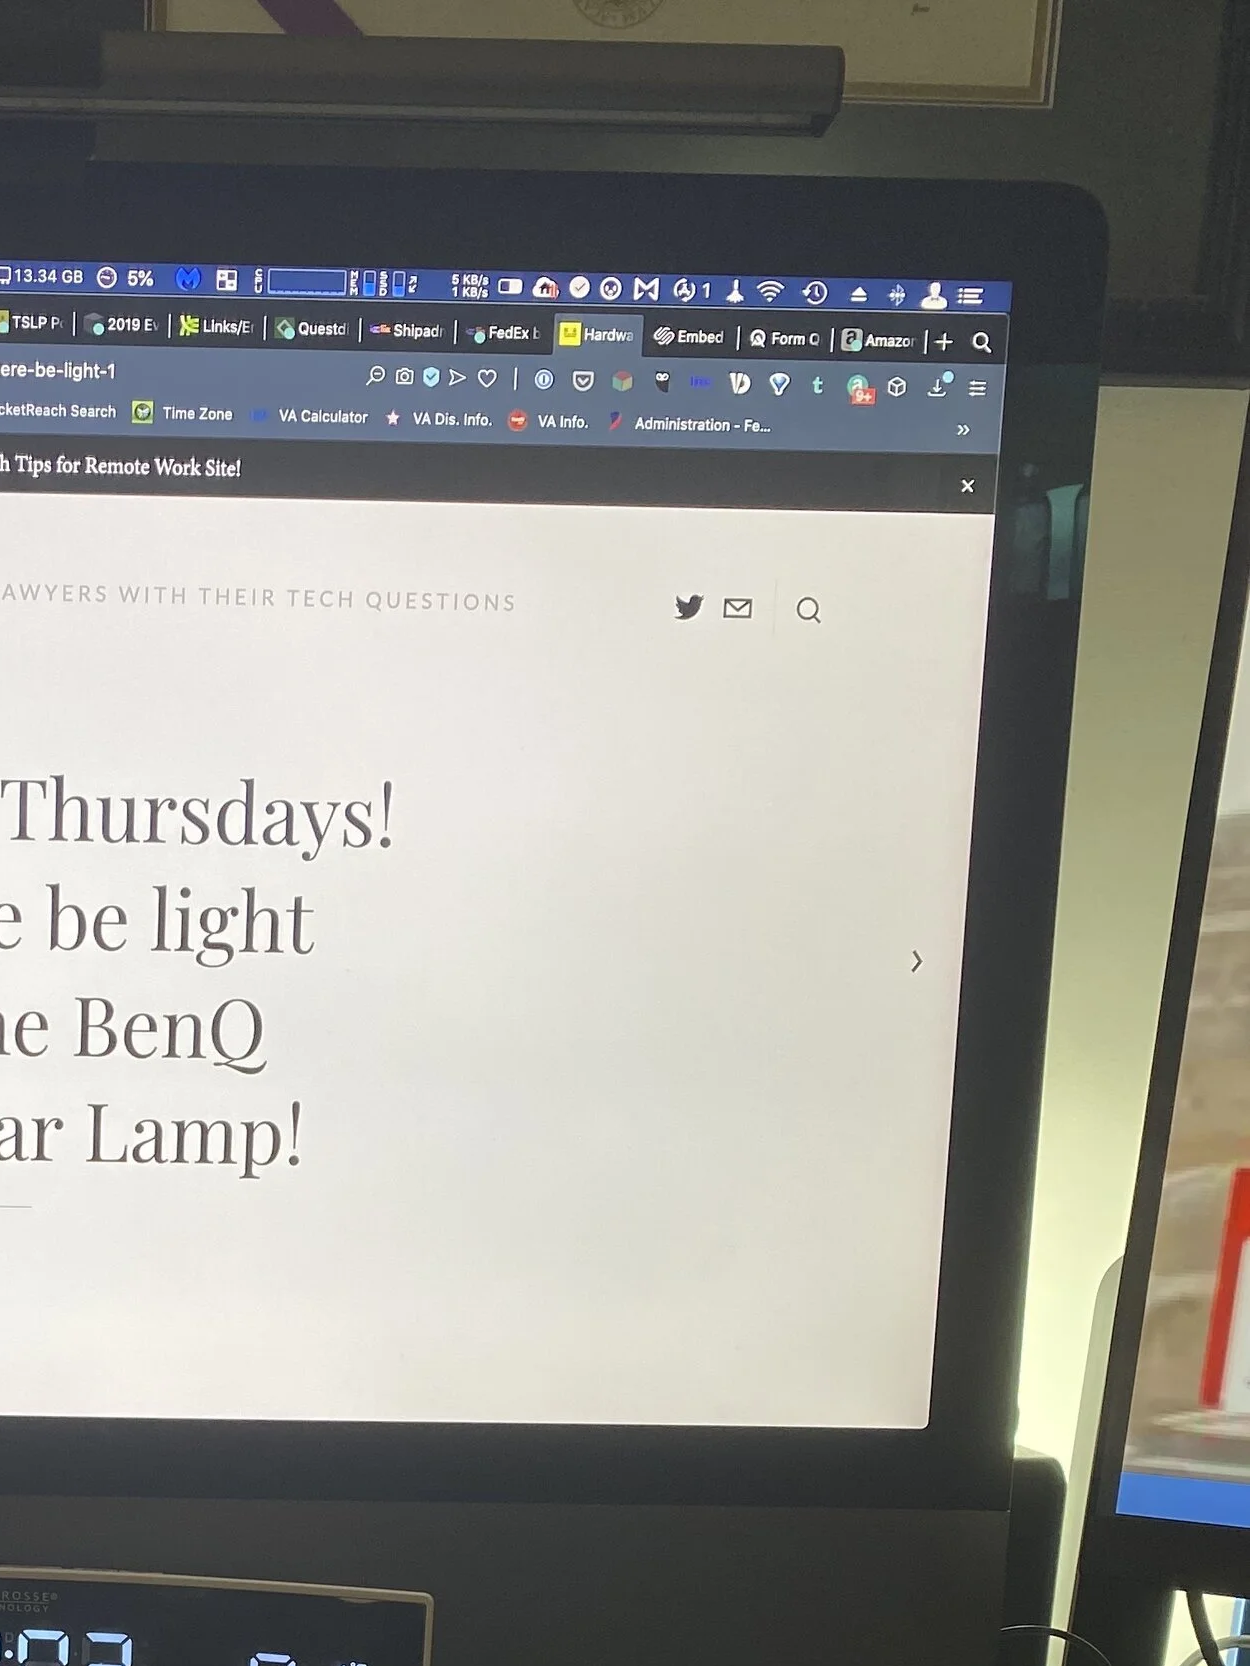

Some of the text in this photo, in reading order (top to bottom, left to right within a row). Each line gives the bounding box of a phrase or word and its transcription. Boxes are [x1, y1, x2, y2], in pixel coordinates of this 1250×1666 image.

[15, 268, 57, 284] 13.34
[62, 268, 84, 285] GB
[127, 270, 155, 287] 5%
[254, 268, 263, 294] CPU
[350, 270, 359, 296] MEM
[379, 271, 388, 297] SSD
[462, 273, 490, 287] KB/s
[462, 286, 488, 300] KB/s
[12, 315, 48, 330] TSLP
[107, 317, 141, 332] 2019
[488, 325, 530, 341] FedEx
[677, 330, 724, 344] Embed
[771, 332, 806, 346] Form
[70, 404, 117, 419] Search
[163, 406, 233, 422] Time Zone
[278, 408, 369, 425] VA Calculator
[412, 411, 493, 428] VA Dis. Info.
[538, 414, 590, 429] VA Info.
[635, 416, 731, 432] Administration
[14, 454, 52, 478] Tips
[56, 455, 82, 475] for
[84, 456, 151, 477] Remote
[153, 457, 202, 478] Work
[205, 458, 242, 479] Site!
[118, 585, 186, 605] WITH
[198, 587, 275, 607] THEIR
[286, 589, 354, 609] TECH
[365, 590, 516, 612] QUESTIONS
[0, 774, 394, 862] Thursdays!
[45, 883, 128, 953] be
[151, 885, 316, 969] light
[73, 995, 269, 1076] BenQ
[84, 1100, 304, 1181] Lamp!
